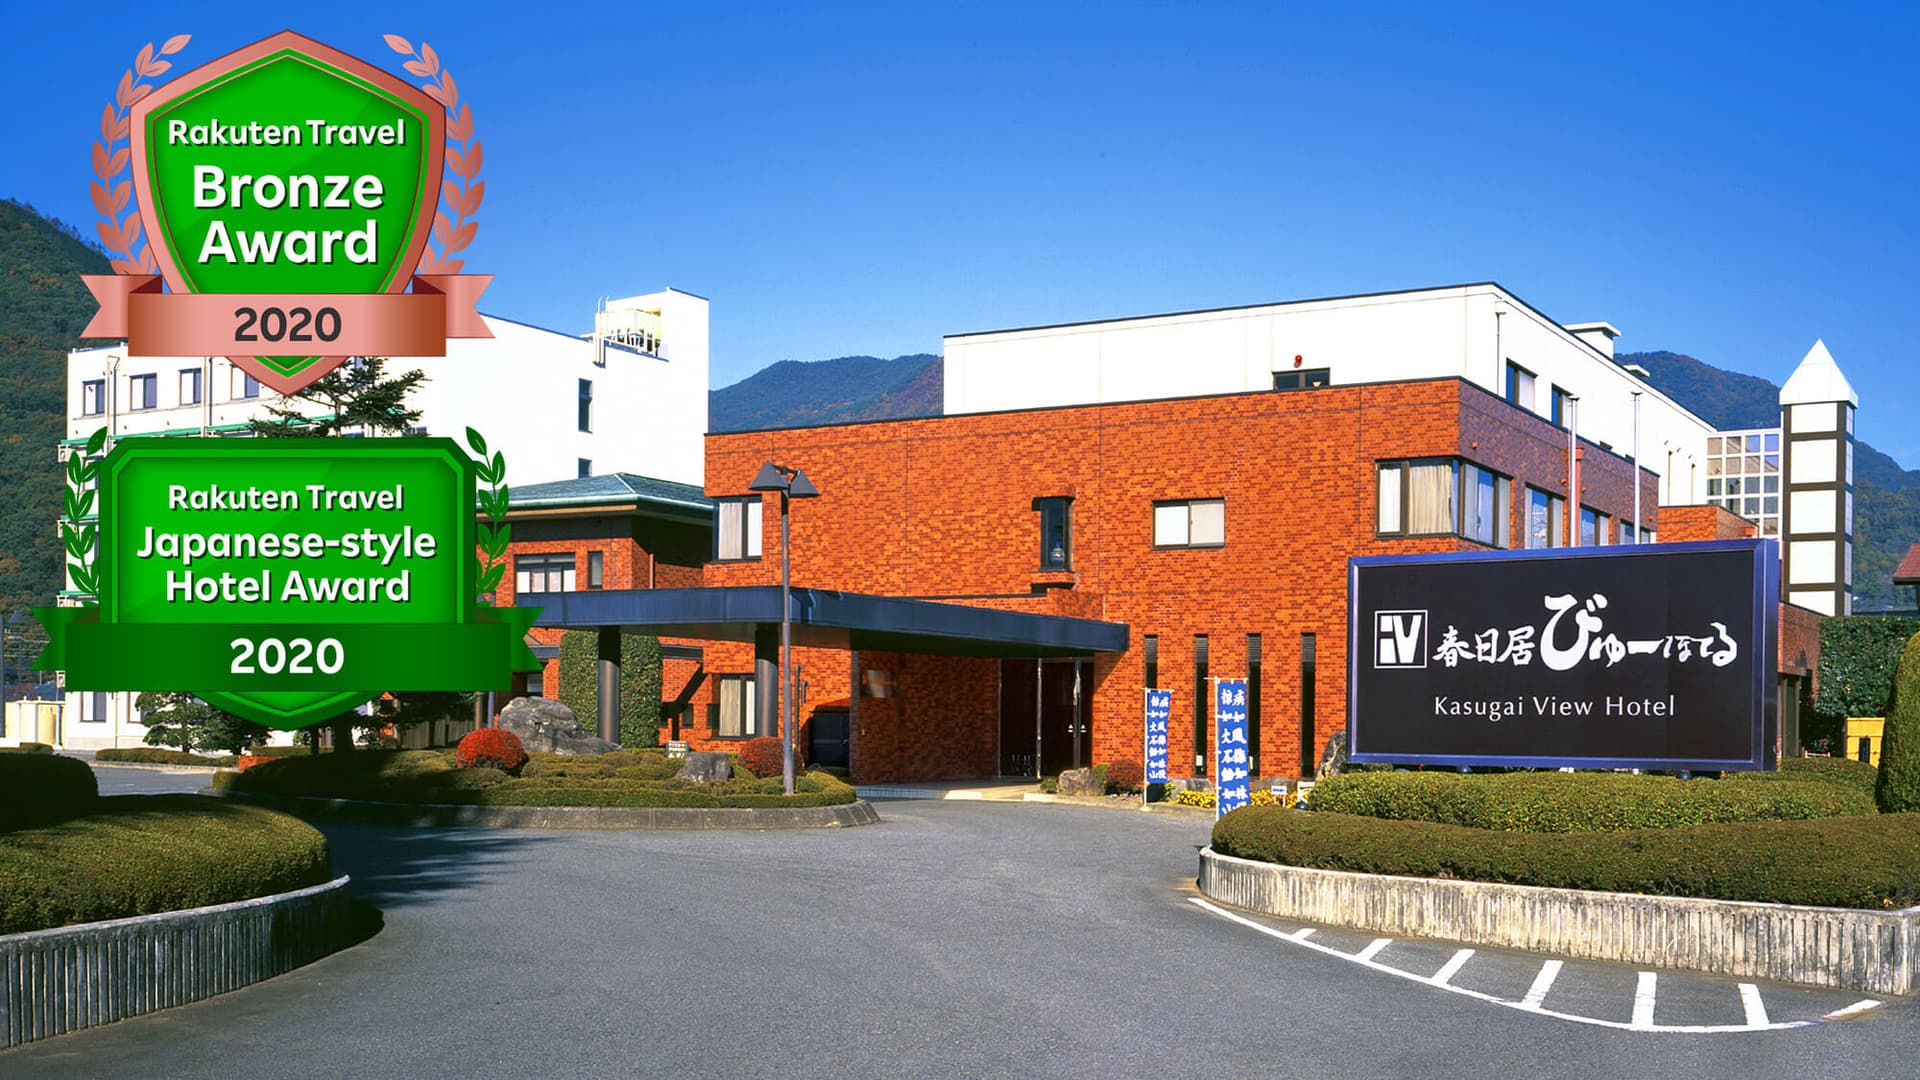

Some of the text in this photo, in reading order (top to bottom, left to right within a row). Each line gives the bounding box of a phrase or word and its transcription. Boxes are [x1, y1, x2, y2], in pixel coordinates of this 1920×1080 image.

[1435, 694, 1674, 722] Kasugai View Hotel
